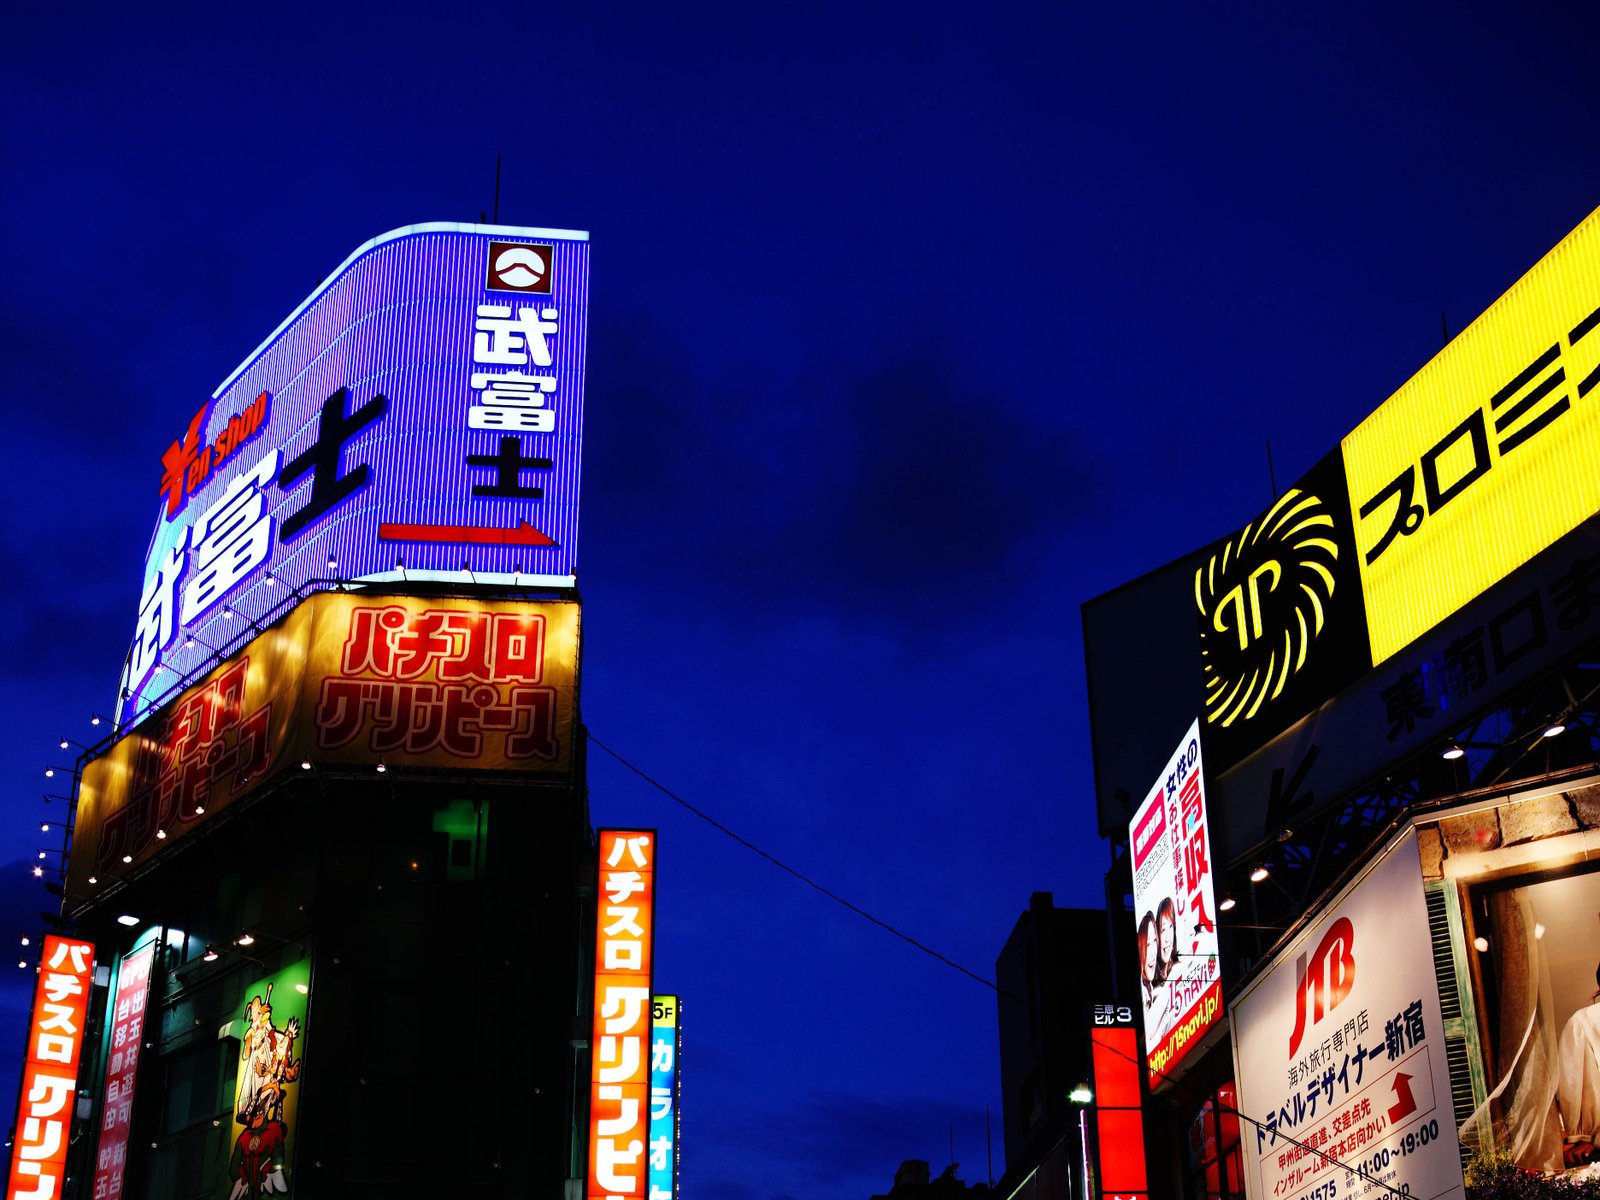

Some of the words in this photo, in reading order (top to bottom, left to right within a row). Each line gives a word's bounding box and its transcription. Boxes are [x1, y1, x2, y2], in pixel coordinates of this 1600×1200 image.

[214, 390, 268, 466] shop
[466, 304, 558, 499] 武富士
[129, 386, 391, 690] 武富士
[344, 606, 546, 684] パチスロ
[314, 678, 558, 760] グリンピース
[1166, 738, 1198, 802] 女性の
[603, 836, 649, 969] パチスロ
[1179, 766, 1214, 956] 高収入
[37, 942, 91, 1064] パチスロ
[653, 1001, 673, 1020] 5F
[1095, 1004, 1114, 1014] 三恵
[1095, 1014, 1114, 1025] ビル
[1117, 1006, 1132, 1023] 3
[1149, 985, 1220, 1078] http://15navi.jp/
[1289, 916, 1356, 1061] JTB
[104, 998, 130, 1131] 台移動自由
[1256, 999, 1426, 1155] トラベルデザイナー新宿
[1287, 1009, 1370, 1091] 海外旅行専門店
[1278, 1098, 1371, 1171] 甲州街道直進、交差点先
